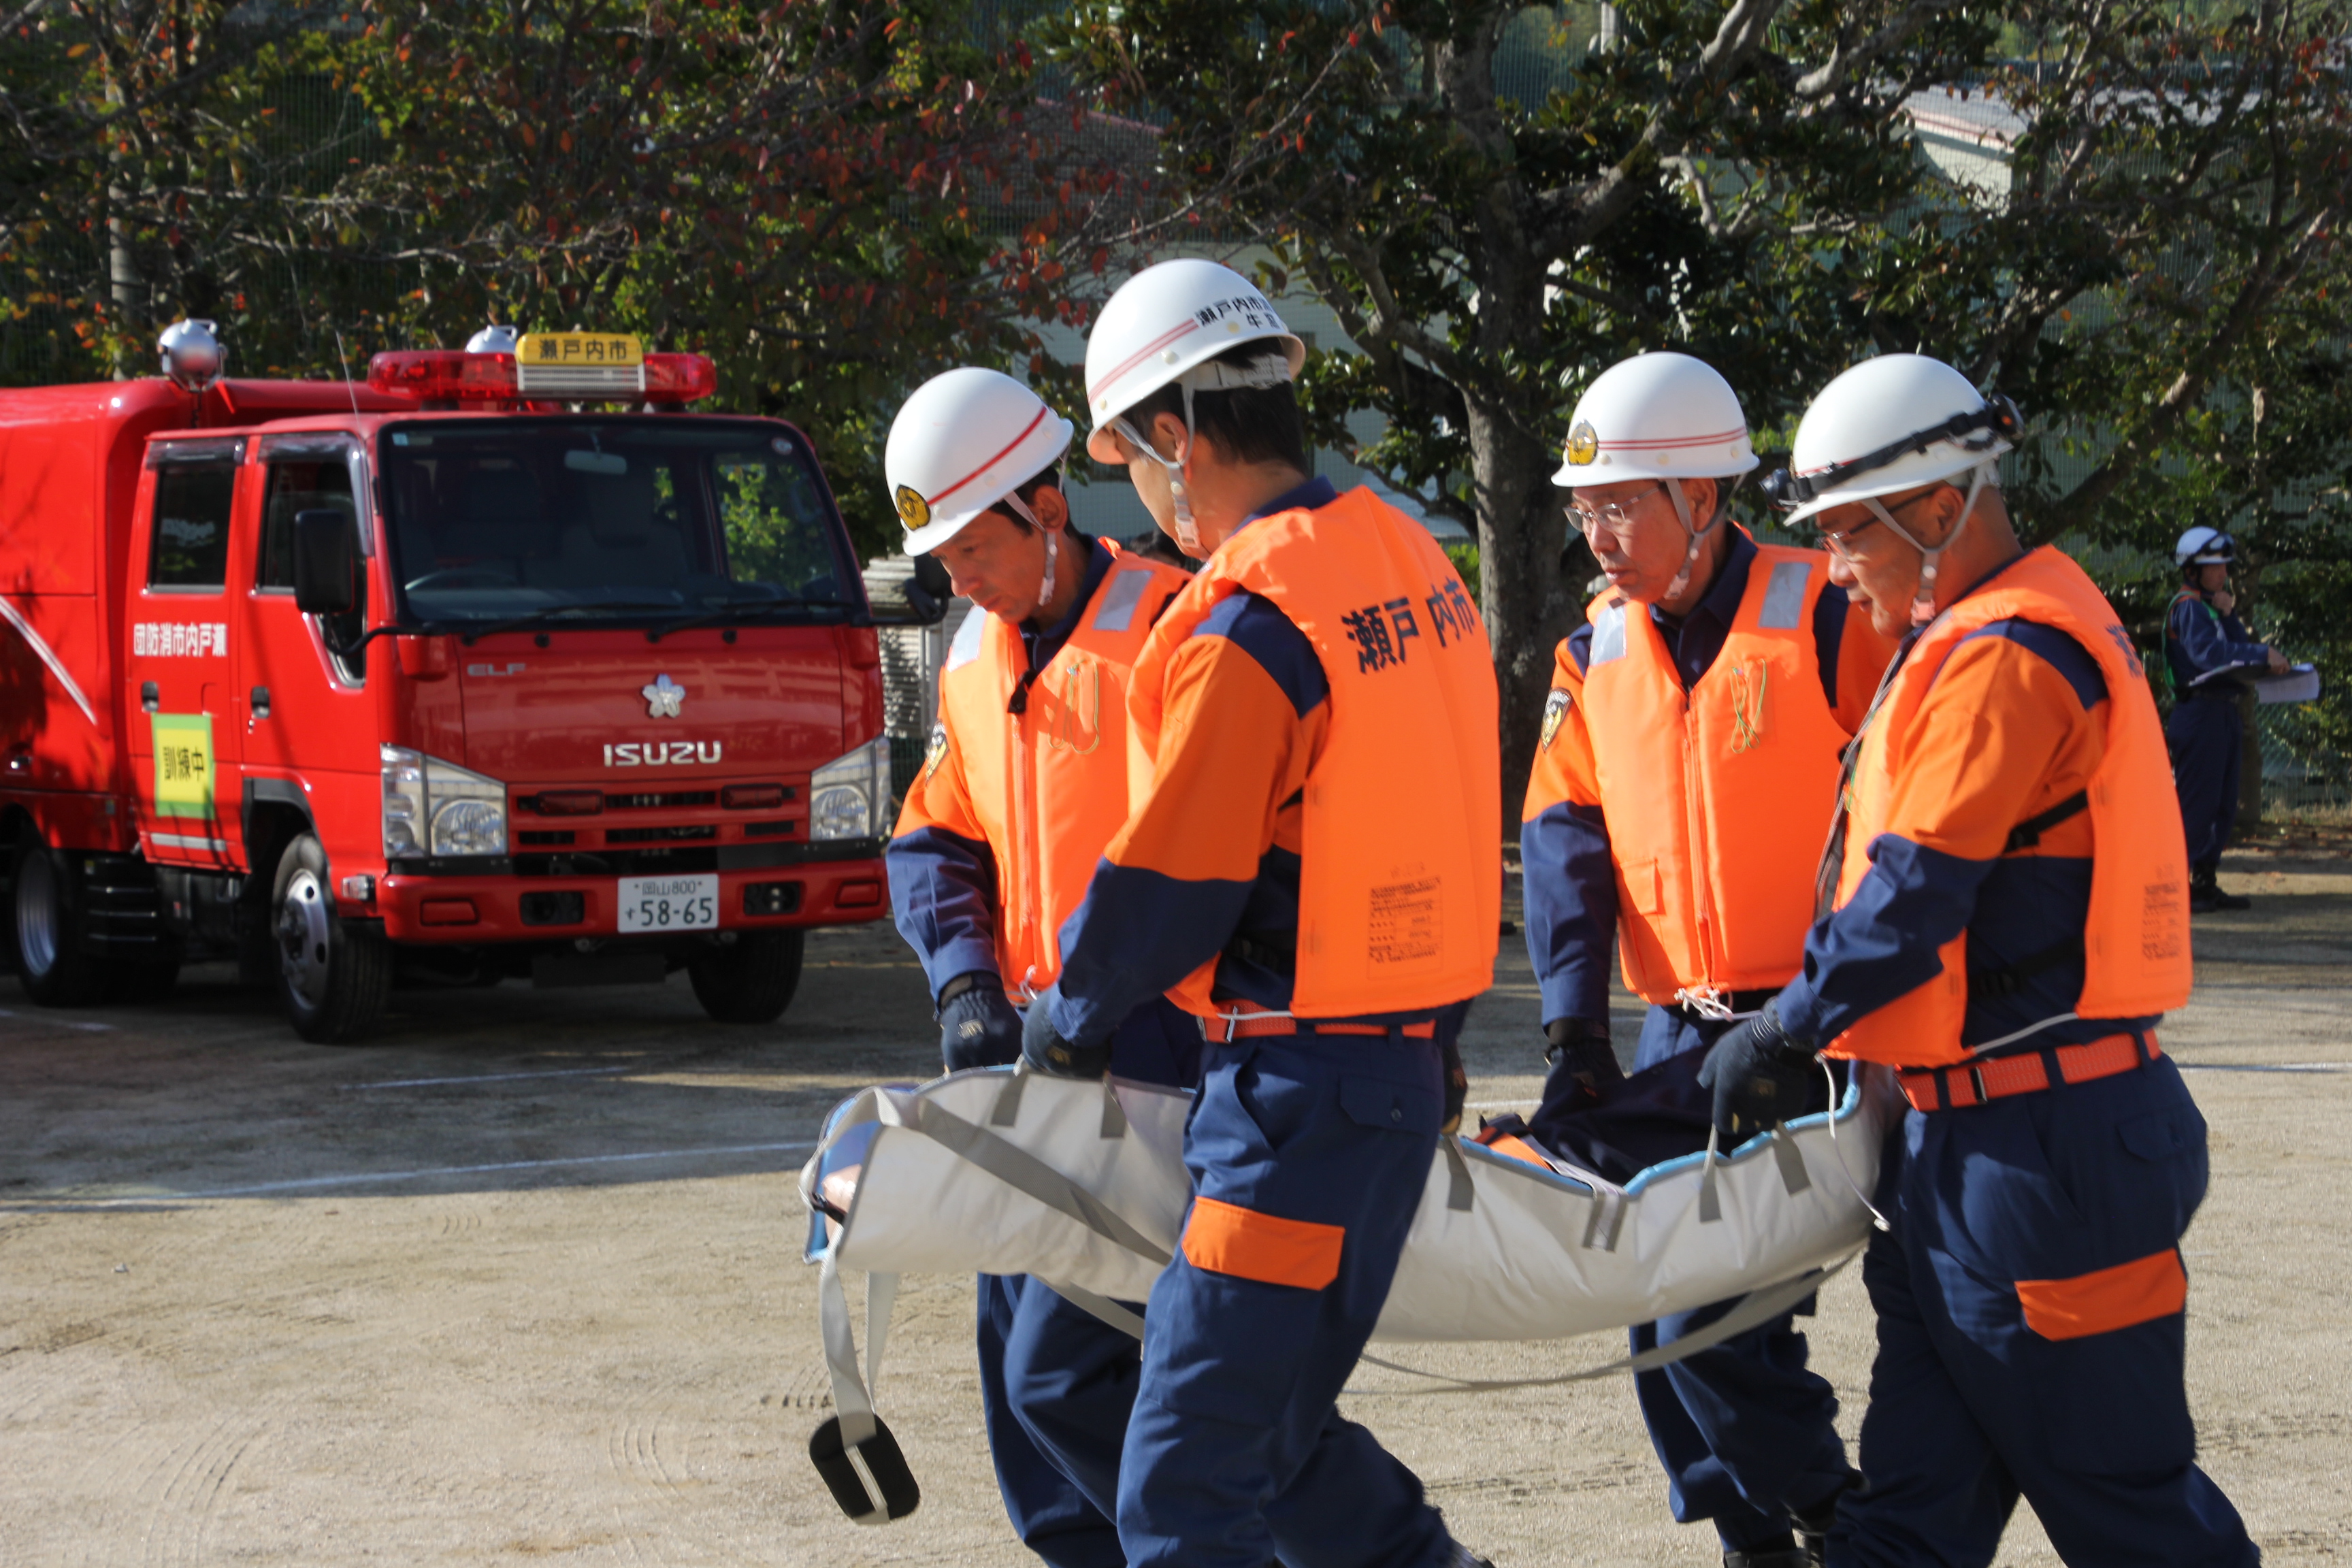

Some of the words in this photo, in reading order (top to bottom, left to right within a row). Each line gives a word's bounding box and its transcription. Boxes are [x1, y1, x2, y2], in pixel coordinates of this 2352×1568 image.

[539, 338, 627, 361] 瀬戸内市
[1340, 576, 1475, 675] 瀬戸内市
[163, 746, 204, 782] 訓練中
[604, 740, 722, 767] ISUZU
